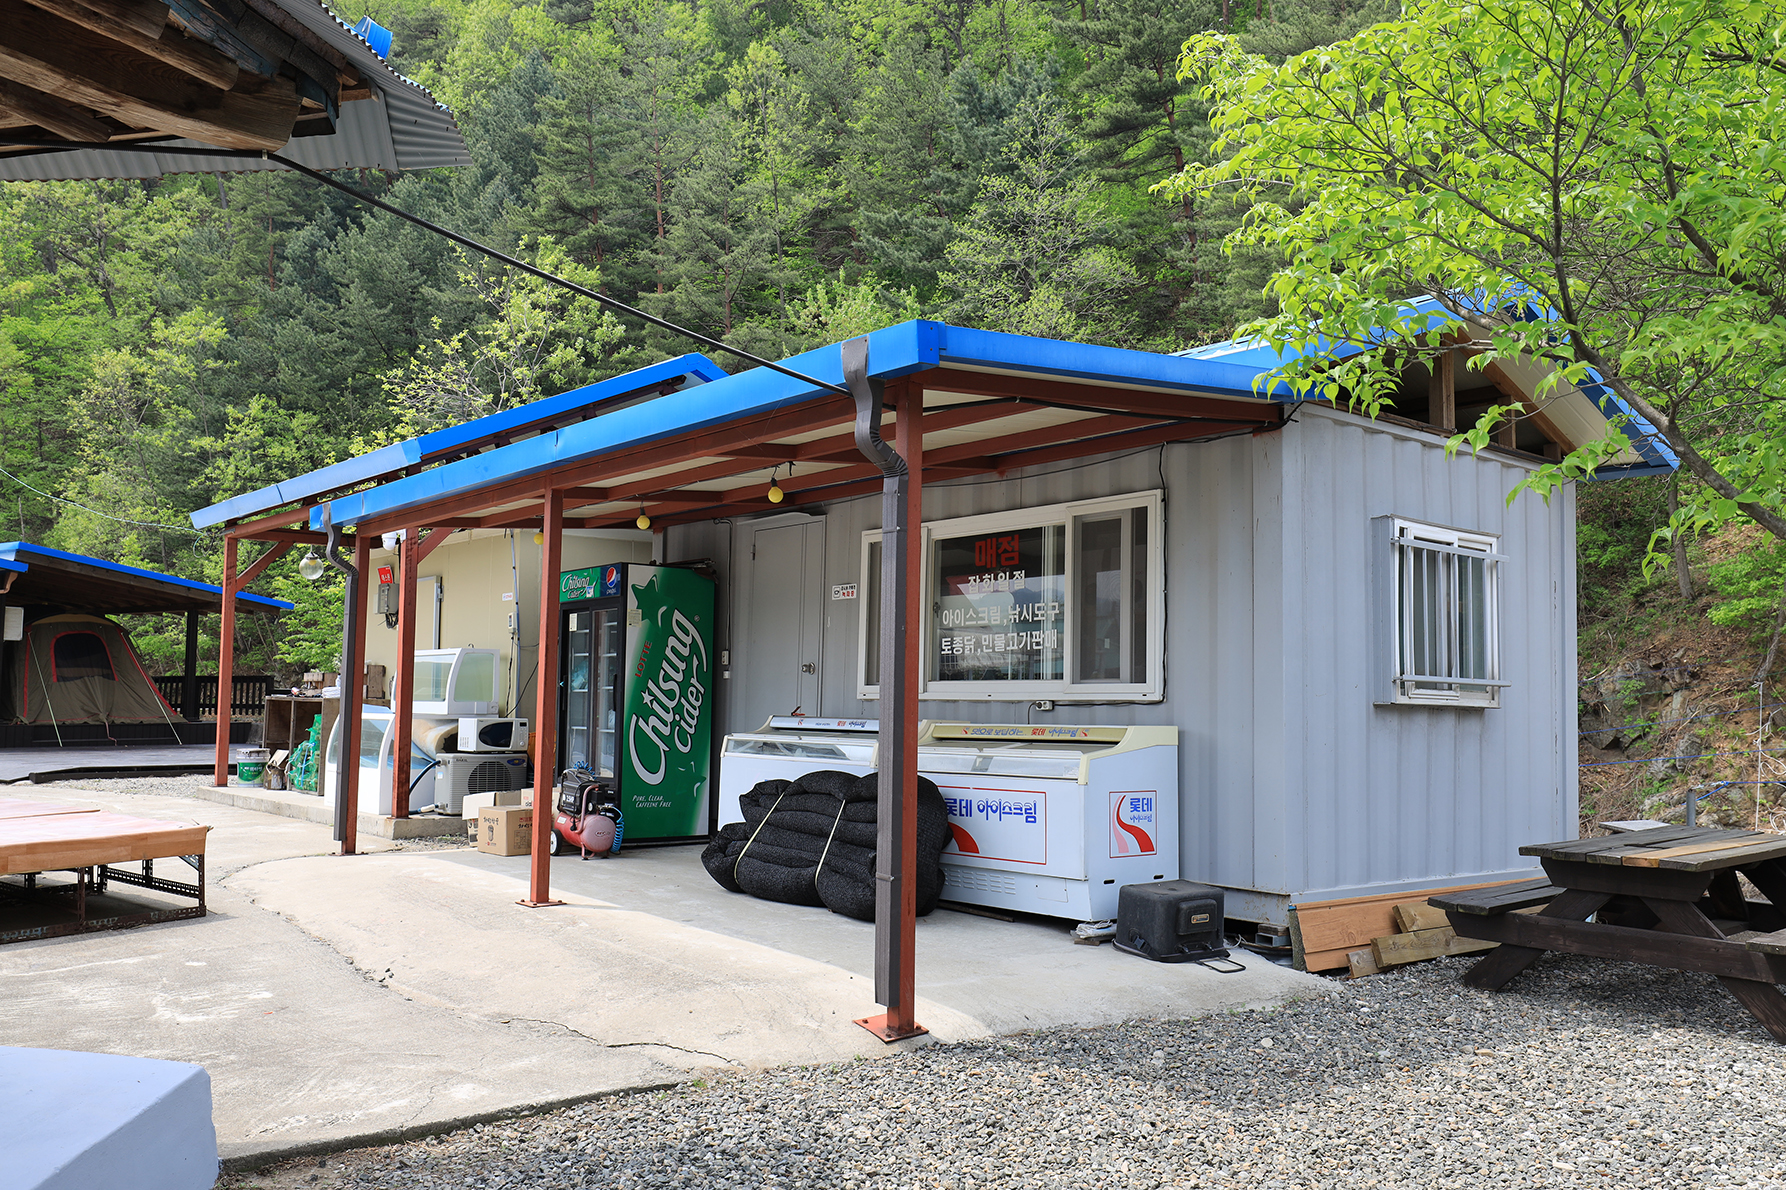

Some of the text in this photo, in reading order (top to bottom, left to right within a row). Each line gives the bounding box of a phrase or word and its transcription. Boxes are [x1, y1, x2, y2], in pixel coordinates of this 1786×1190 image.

[975, 534, 1019, 568] 매점
[562, 573, 590, 592] Chilsung
[968, 570, 1025, 594] 잡화일절
[635, 640, 652, 678] LOTTE
[629, 608, 707, 785] Chilsung
[1031, 728, 1046, 736] 롯데
[944, 797, 1037, 824] 롯데 아이스크림
[1129, 797, 1153, 813] 롯데
